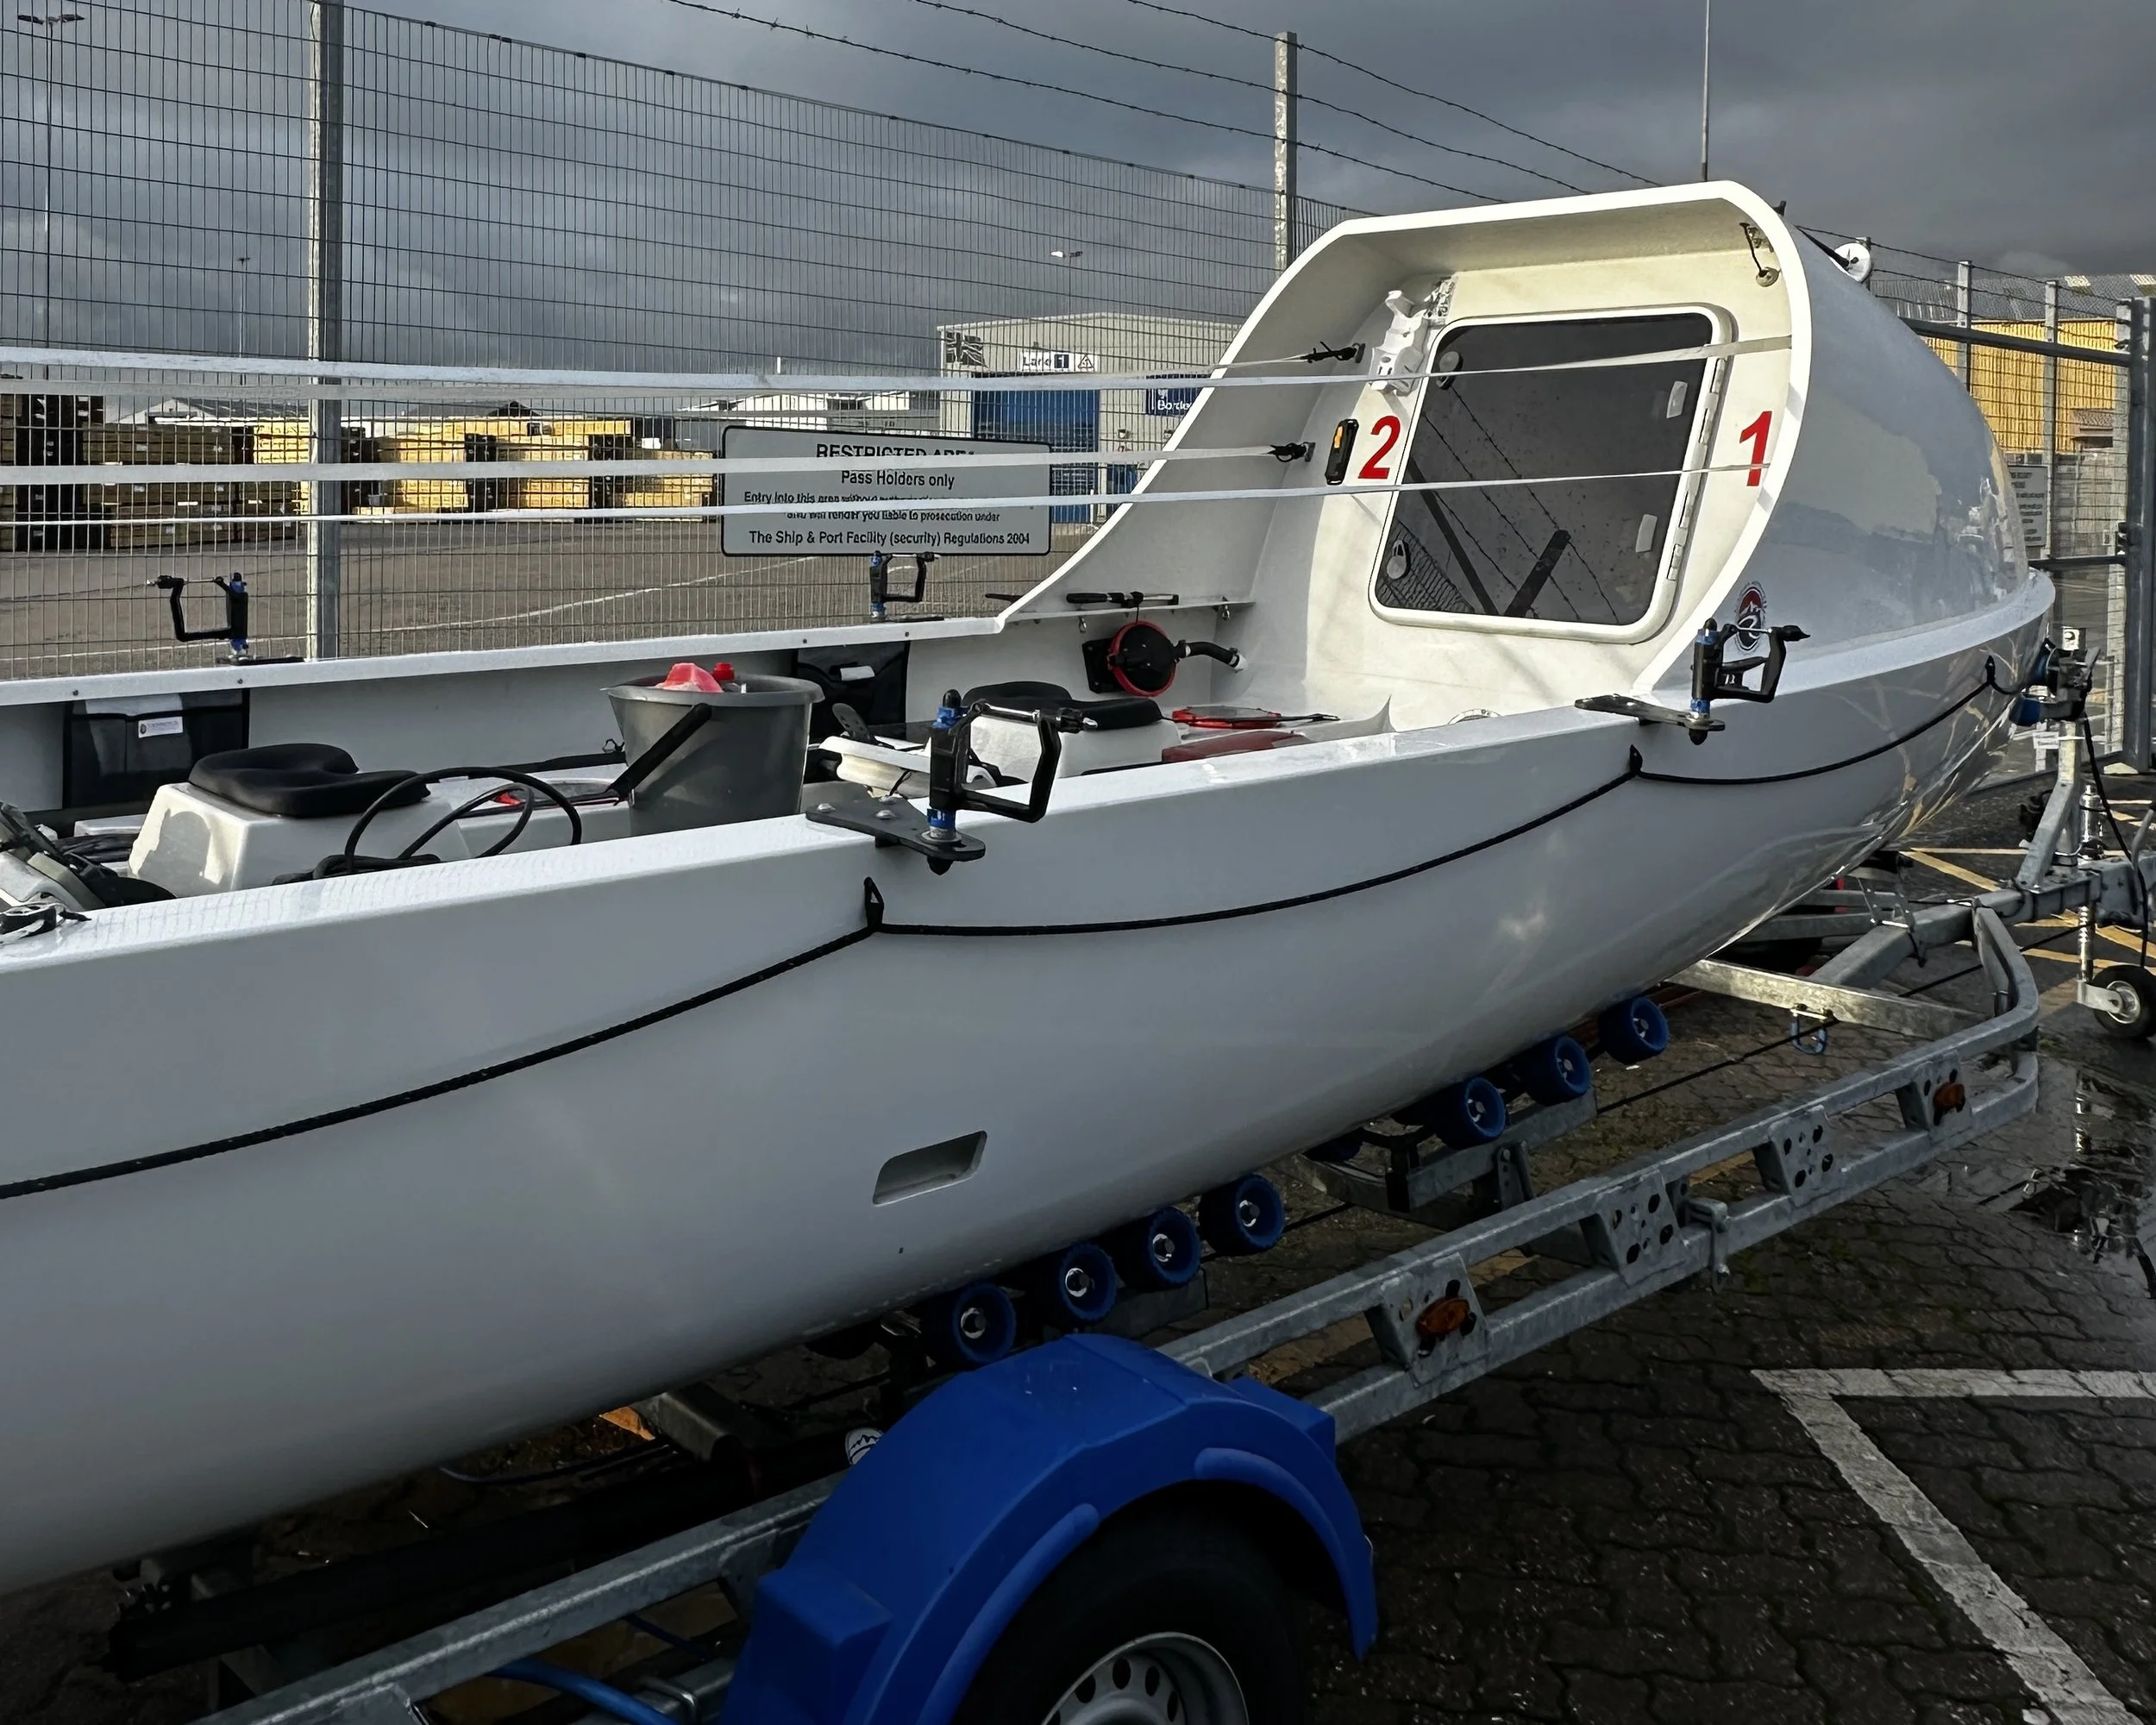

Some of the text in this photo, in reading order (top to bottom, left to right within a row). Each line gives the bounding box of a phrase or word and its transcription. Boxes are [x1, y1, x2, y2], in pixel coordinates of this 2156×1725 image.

[1357, 415, 1401, 480] 2
[1739, 411, 1772, 486] 1
[842, 470, 955, 490] Pass Holders only
[744, 492, 772, 504] Entry
[774, 492, 794, 503] into
[797, 492, 816, 503] this
[909, 510, 918, 520] to
[920, 511, 973, 523] prosecution
[975, 512, 1000, 522] under
[749, 530, 1030, 547] The Ship & Port Facility (security) Regulations 2004
